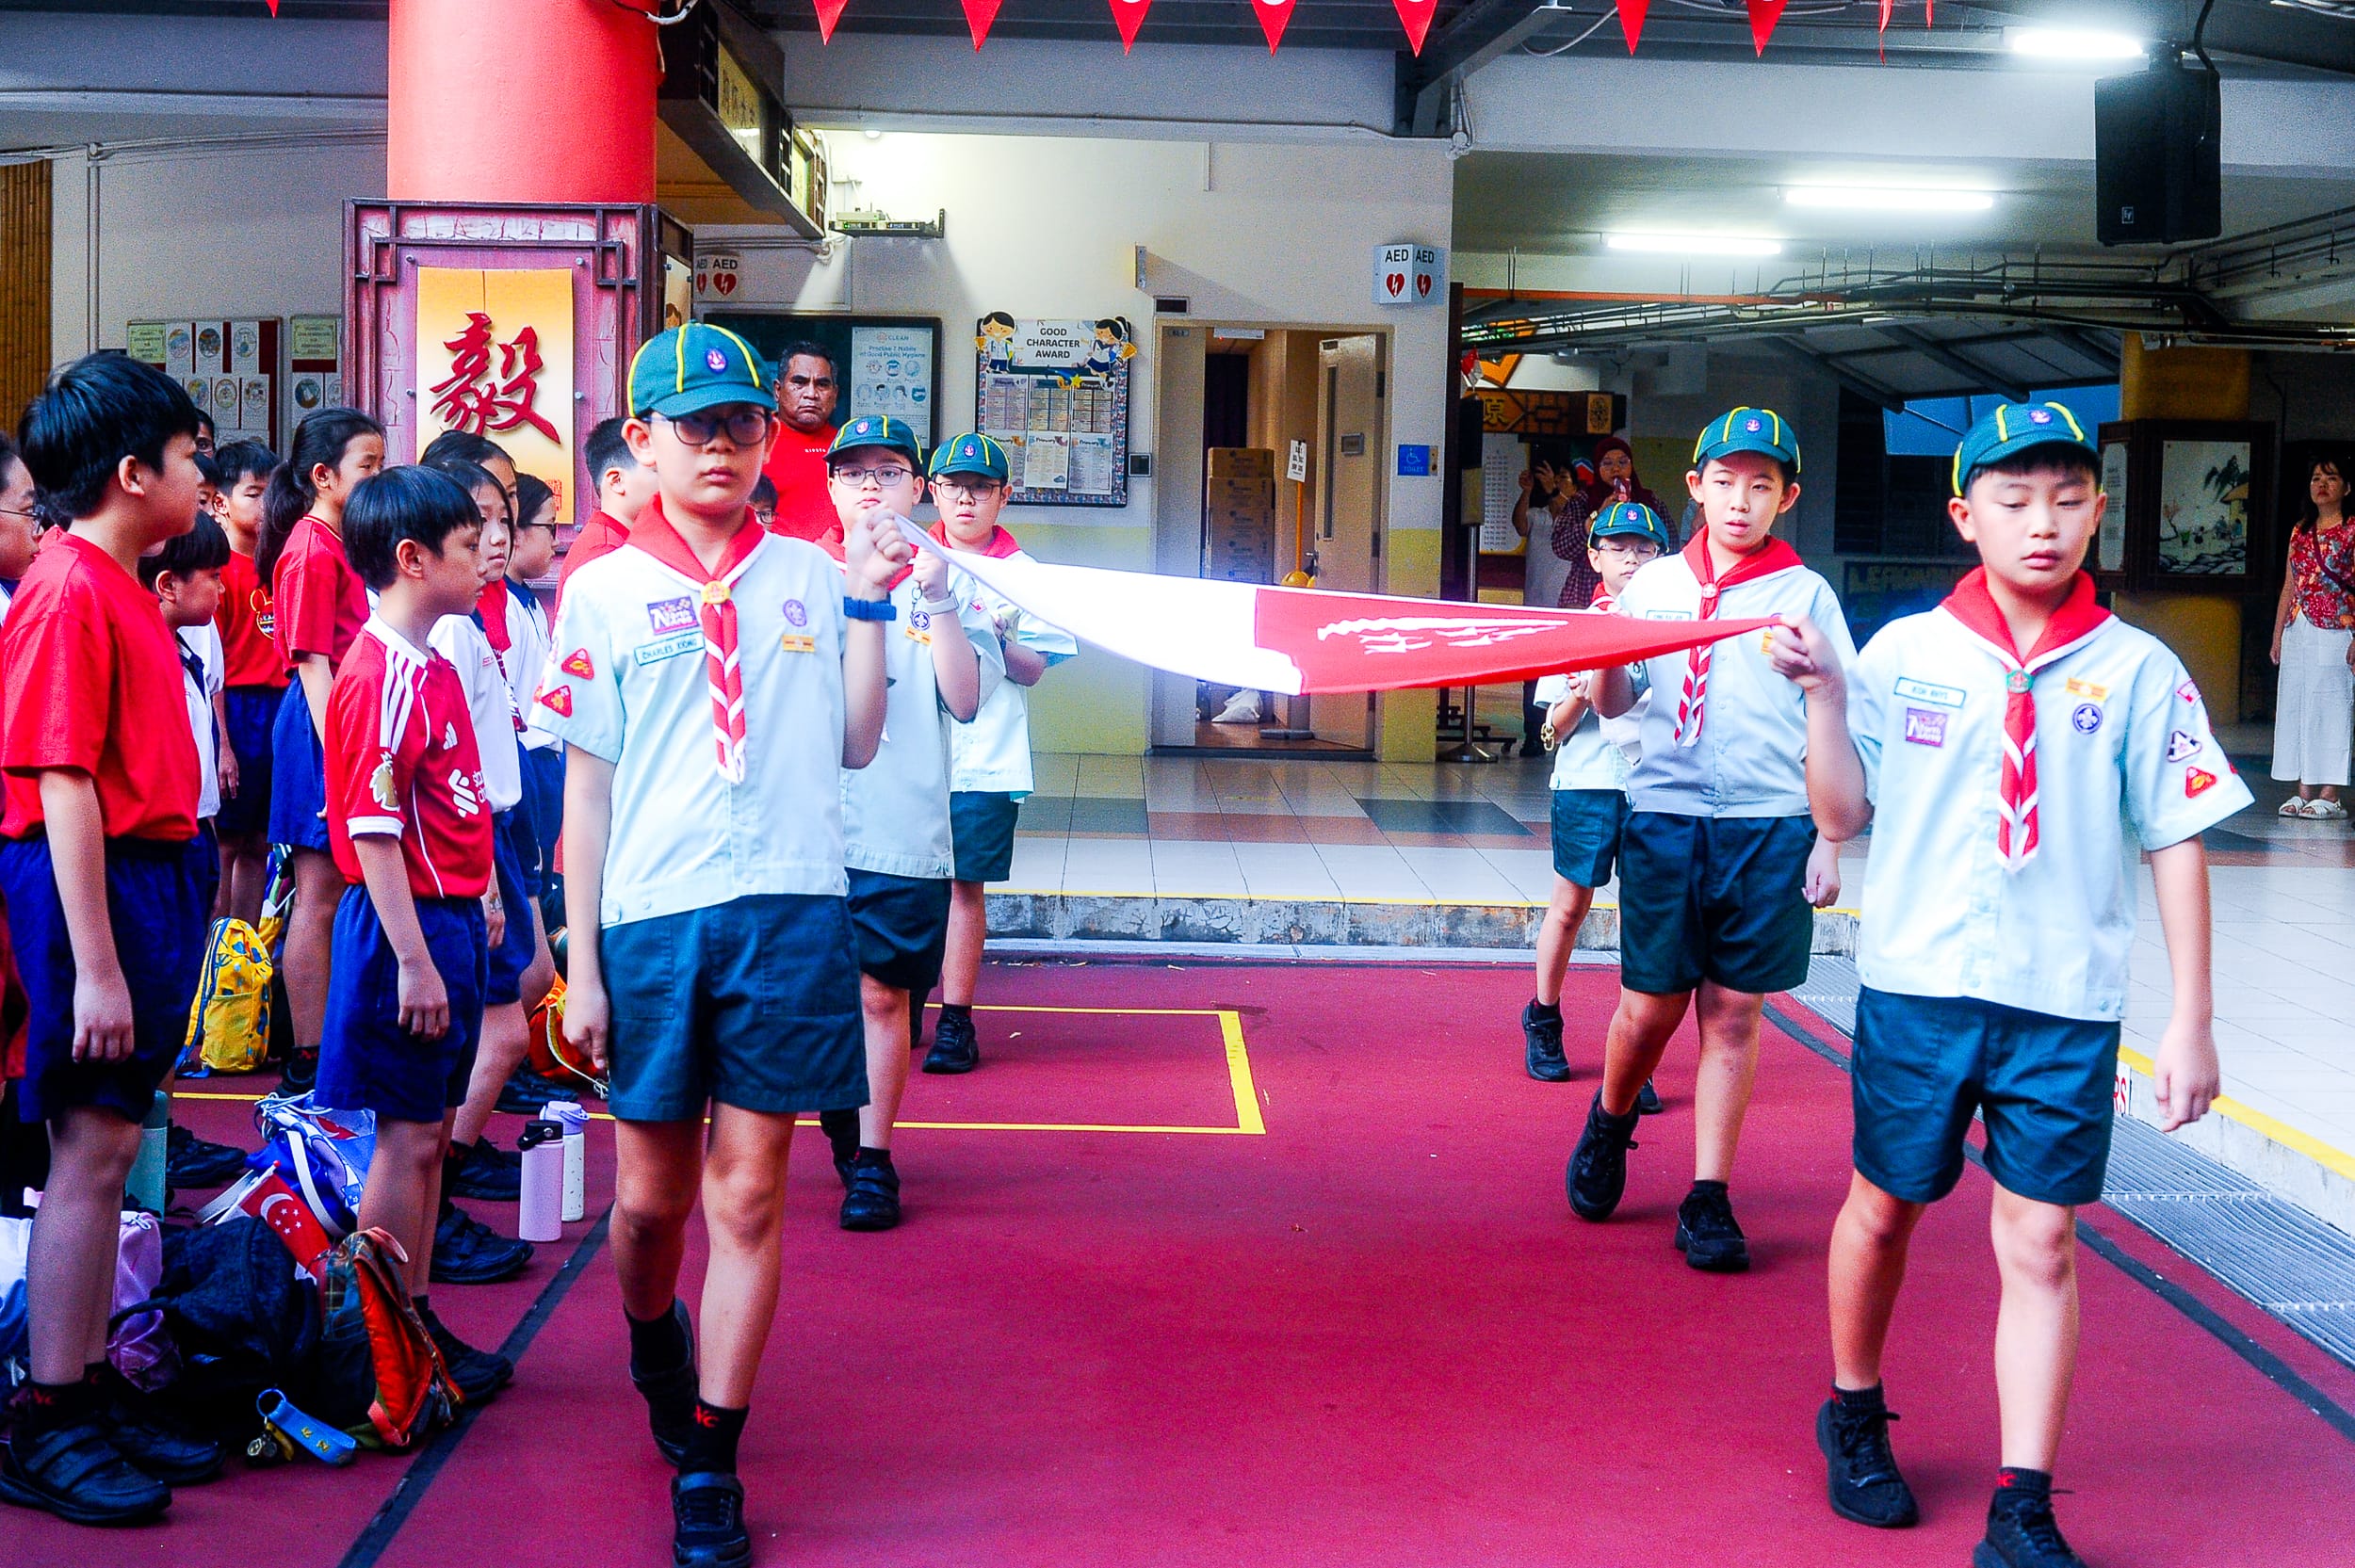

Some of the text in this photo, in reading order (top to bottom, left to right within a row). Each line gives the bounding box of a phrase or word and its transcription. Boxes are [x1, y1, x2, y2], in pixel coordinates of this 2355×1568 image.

[1385, 249, 1409, 263] AED
[1415, 250, 1435, 264] AED
[712, 258, 738, 269] AED
[1040, 328, 1067, 336] GOOD
[1027, 338, 1080, 348] CHARACTER
[1035, 349, 1070, 358] AWARD
[430, 312, 560, 445] 毅
